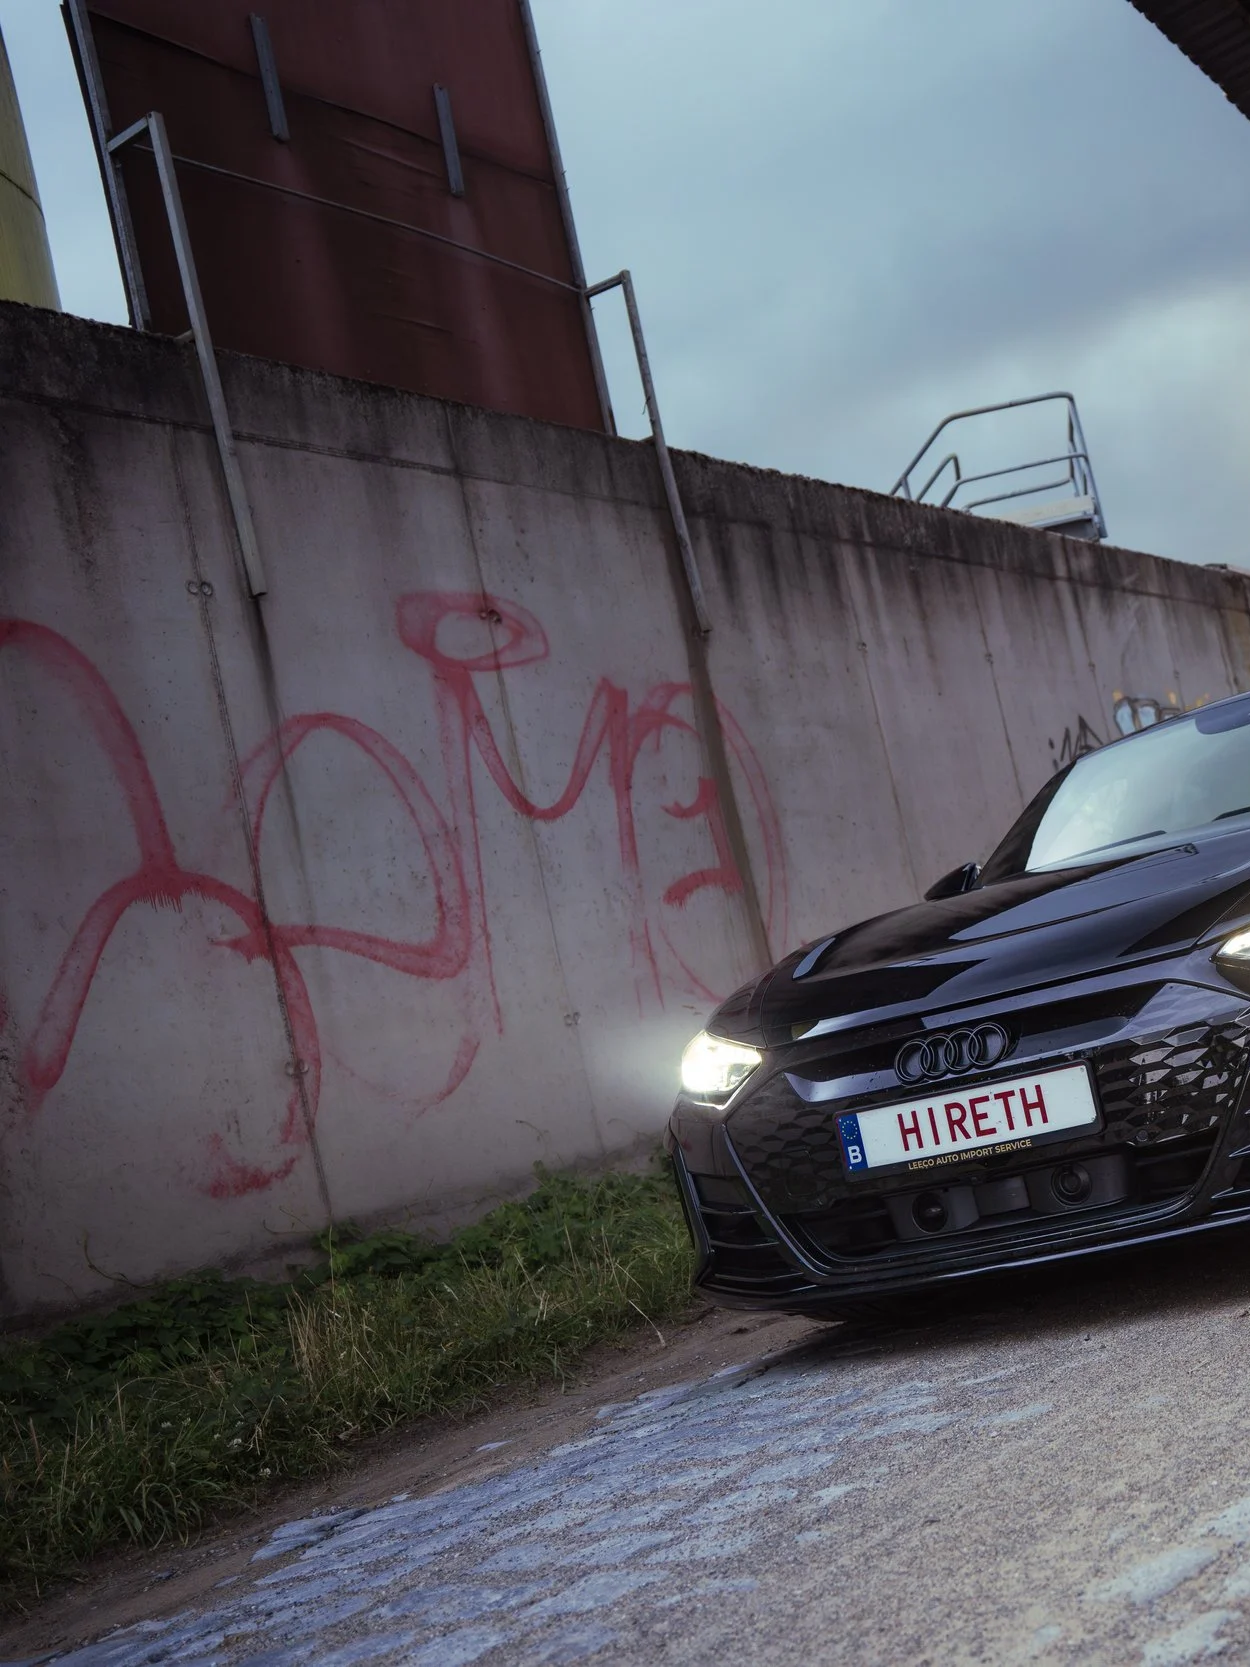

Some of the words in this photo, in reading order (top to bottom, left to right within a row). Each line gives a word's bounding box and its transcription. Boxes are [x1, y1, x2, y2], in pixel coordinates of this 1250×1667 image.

[897, 1084, 1049, 1152] HIRETH
[847, 1145, 862, 1164] B
[936, 1153, 959, 1165] AUTO
[960, 1146, 993, 1161] IMPORT
[995, 1138, 1032, 1154] SERVICE
